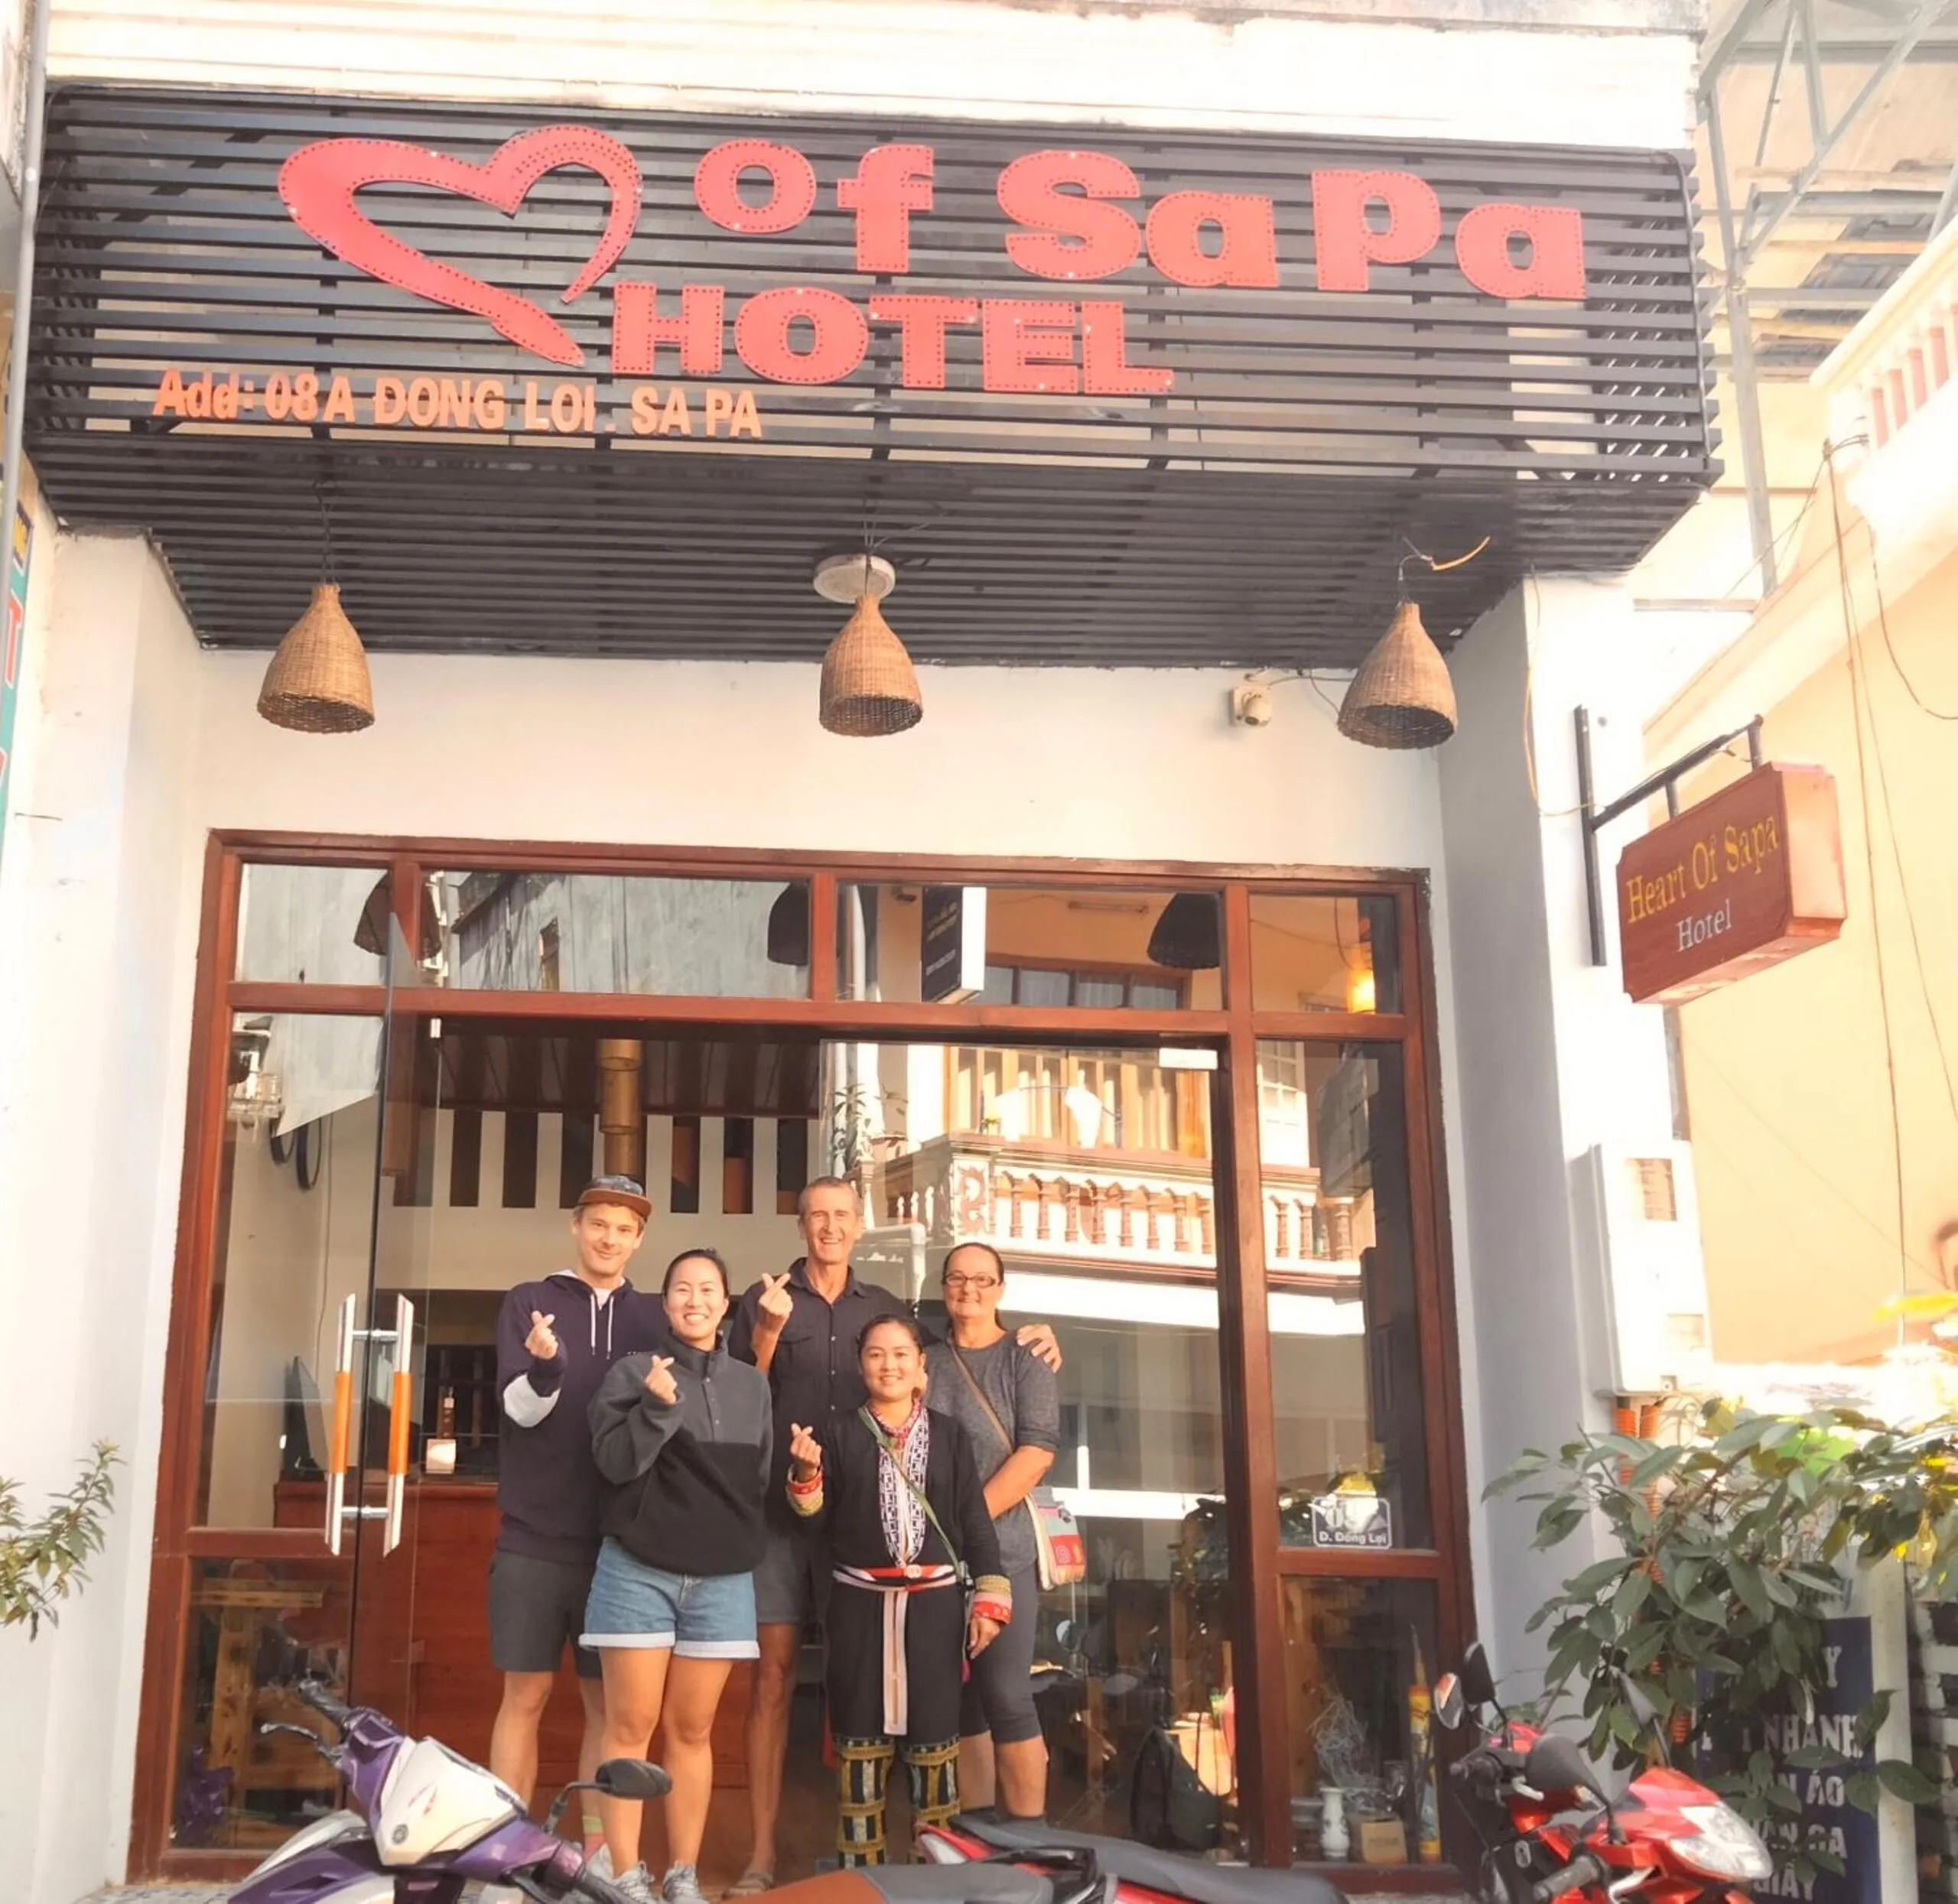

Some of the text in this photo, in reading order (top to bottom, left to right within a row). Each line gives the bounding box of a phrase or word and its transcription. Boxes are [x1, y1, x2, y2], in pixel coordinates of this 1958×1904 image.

[612, 281, 1175, 395] HOTEL
[1625, 815, 1778, 923] Heart Of Sapa
[1676, 898, 1732, 952] Hotel
